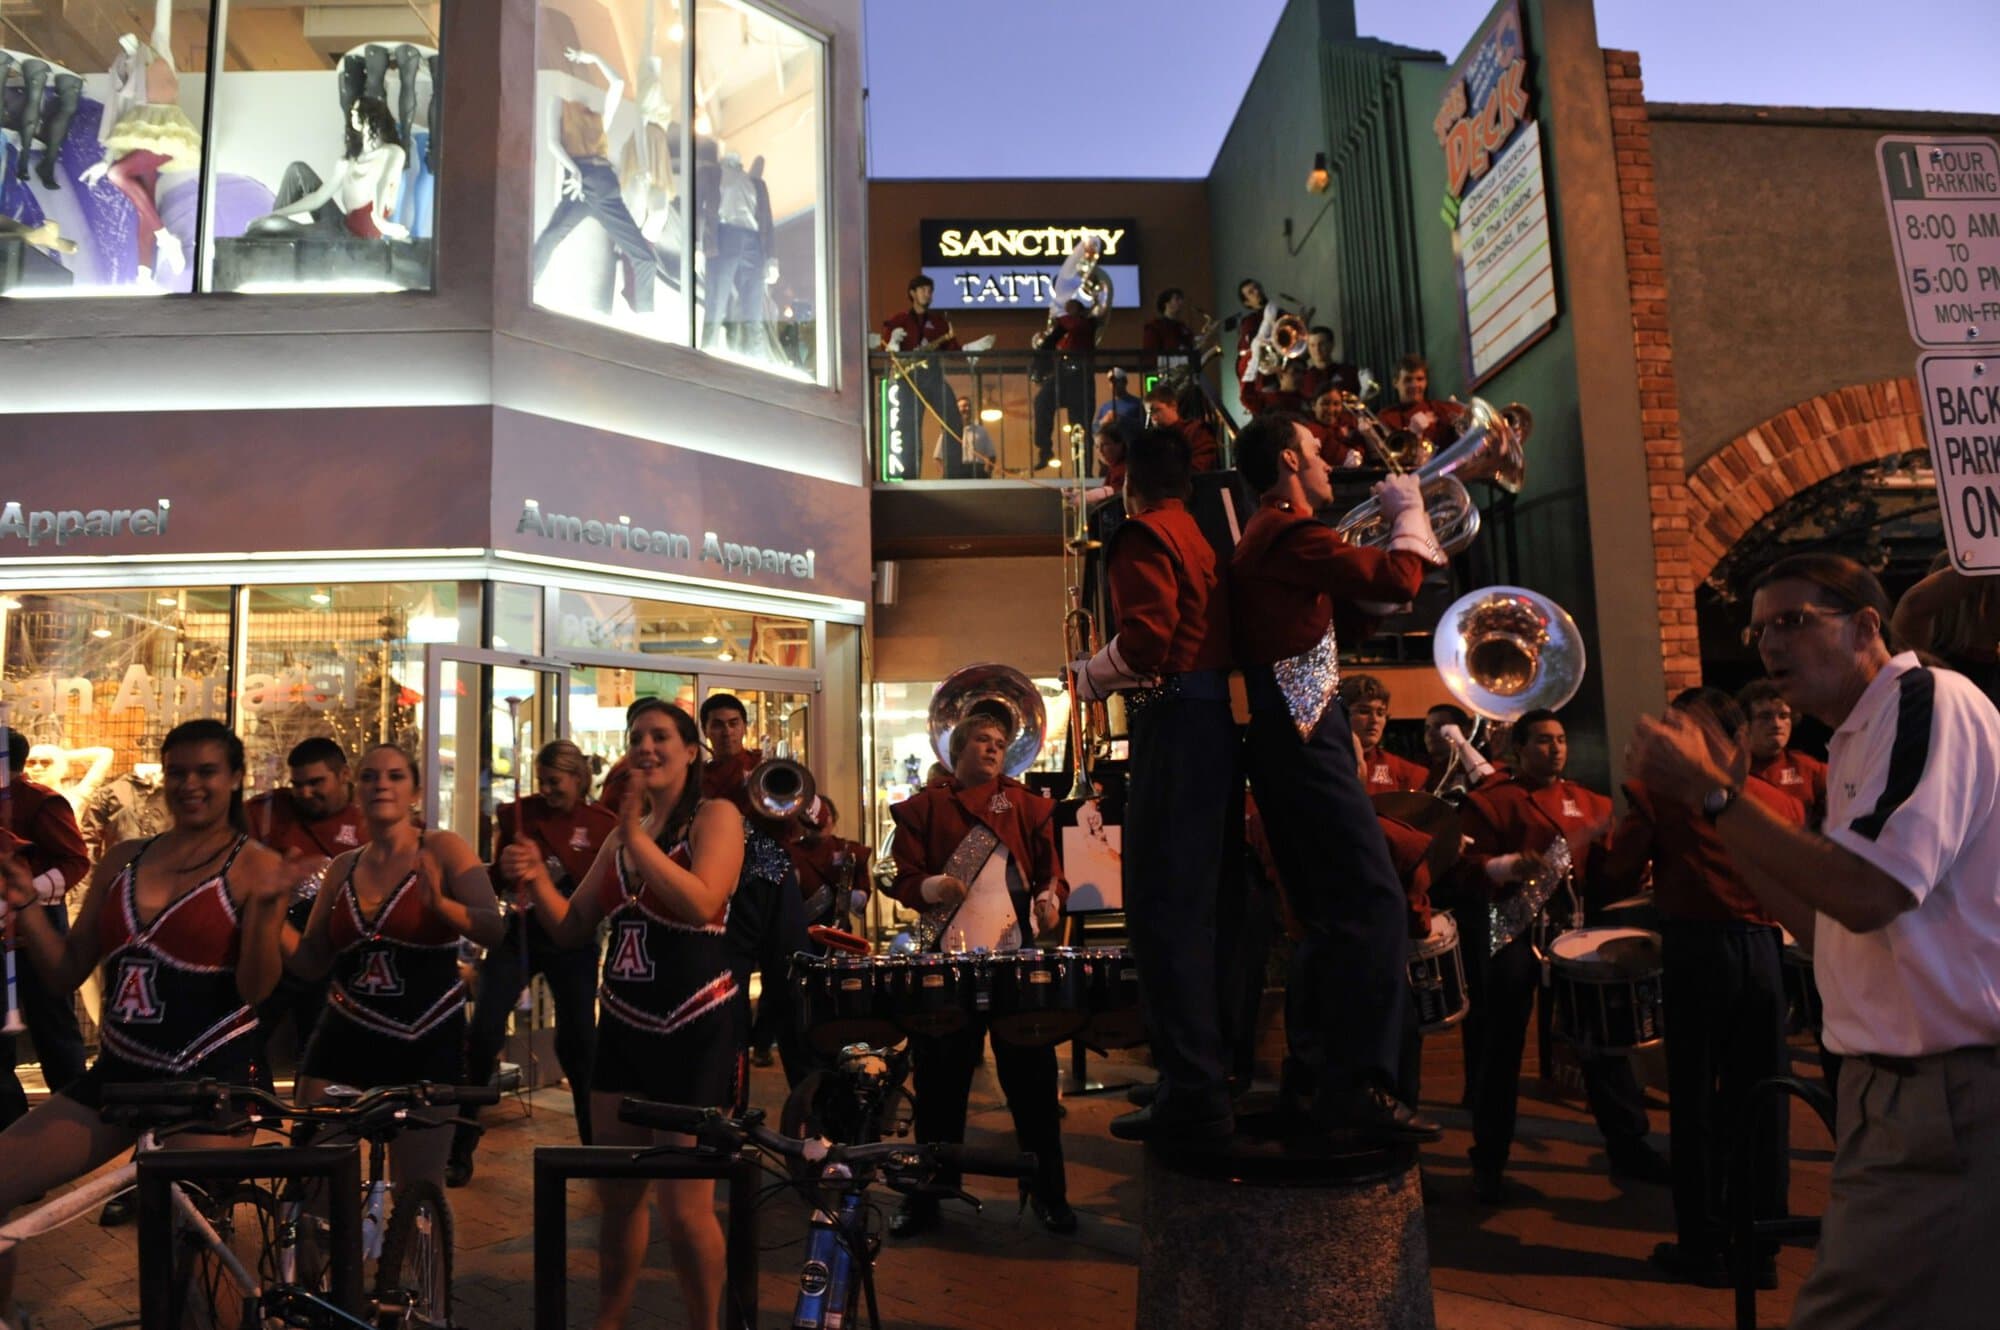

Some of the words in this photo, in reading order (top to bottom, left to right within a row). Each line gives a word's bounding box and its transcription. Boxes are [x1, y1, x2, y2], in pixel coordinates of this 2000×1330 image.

[1445, 58, 1531, 198] DECK
[1899, 151, 1913, 189] 1
[1930, 152, 1985, 173] HOUR
[1926, 173, 1997, 193] PARKING
[1906, 214, 1956, 240] 8:00
[1968, 213, 2000, 239] AM
[1946, 243, 1969, 263] TO
[954, 270, 1094, 303] TATT
[1913, 267, 1969, 294] 5:00
[0, 498, 171, 547] Apparel
[516, 499, 691, 561] American
[700, 531, 816, 580] Apparel
[608, 920, 656, 983] A
[110, 957, 165, 1024] A
[347, 946, 405, 997] A
